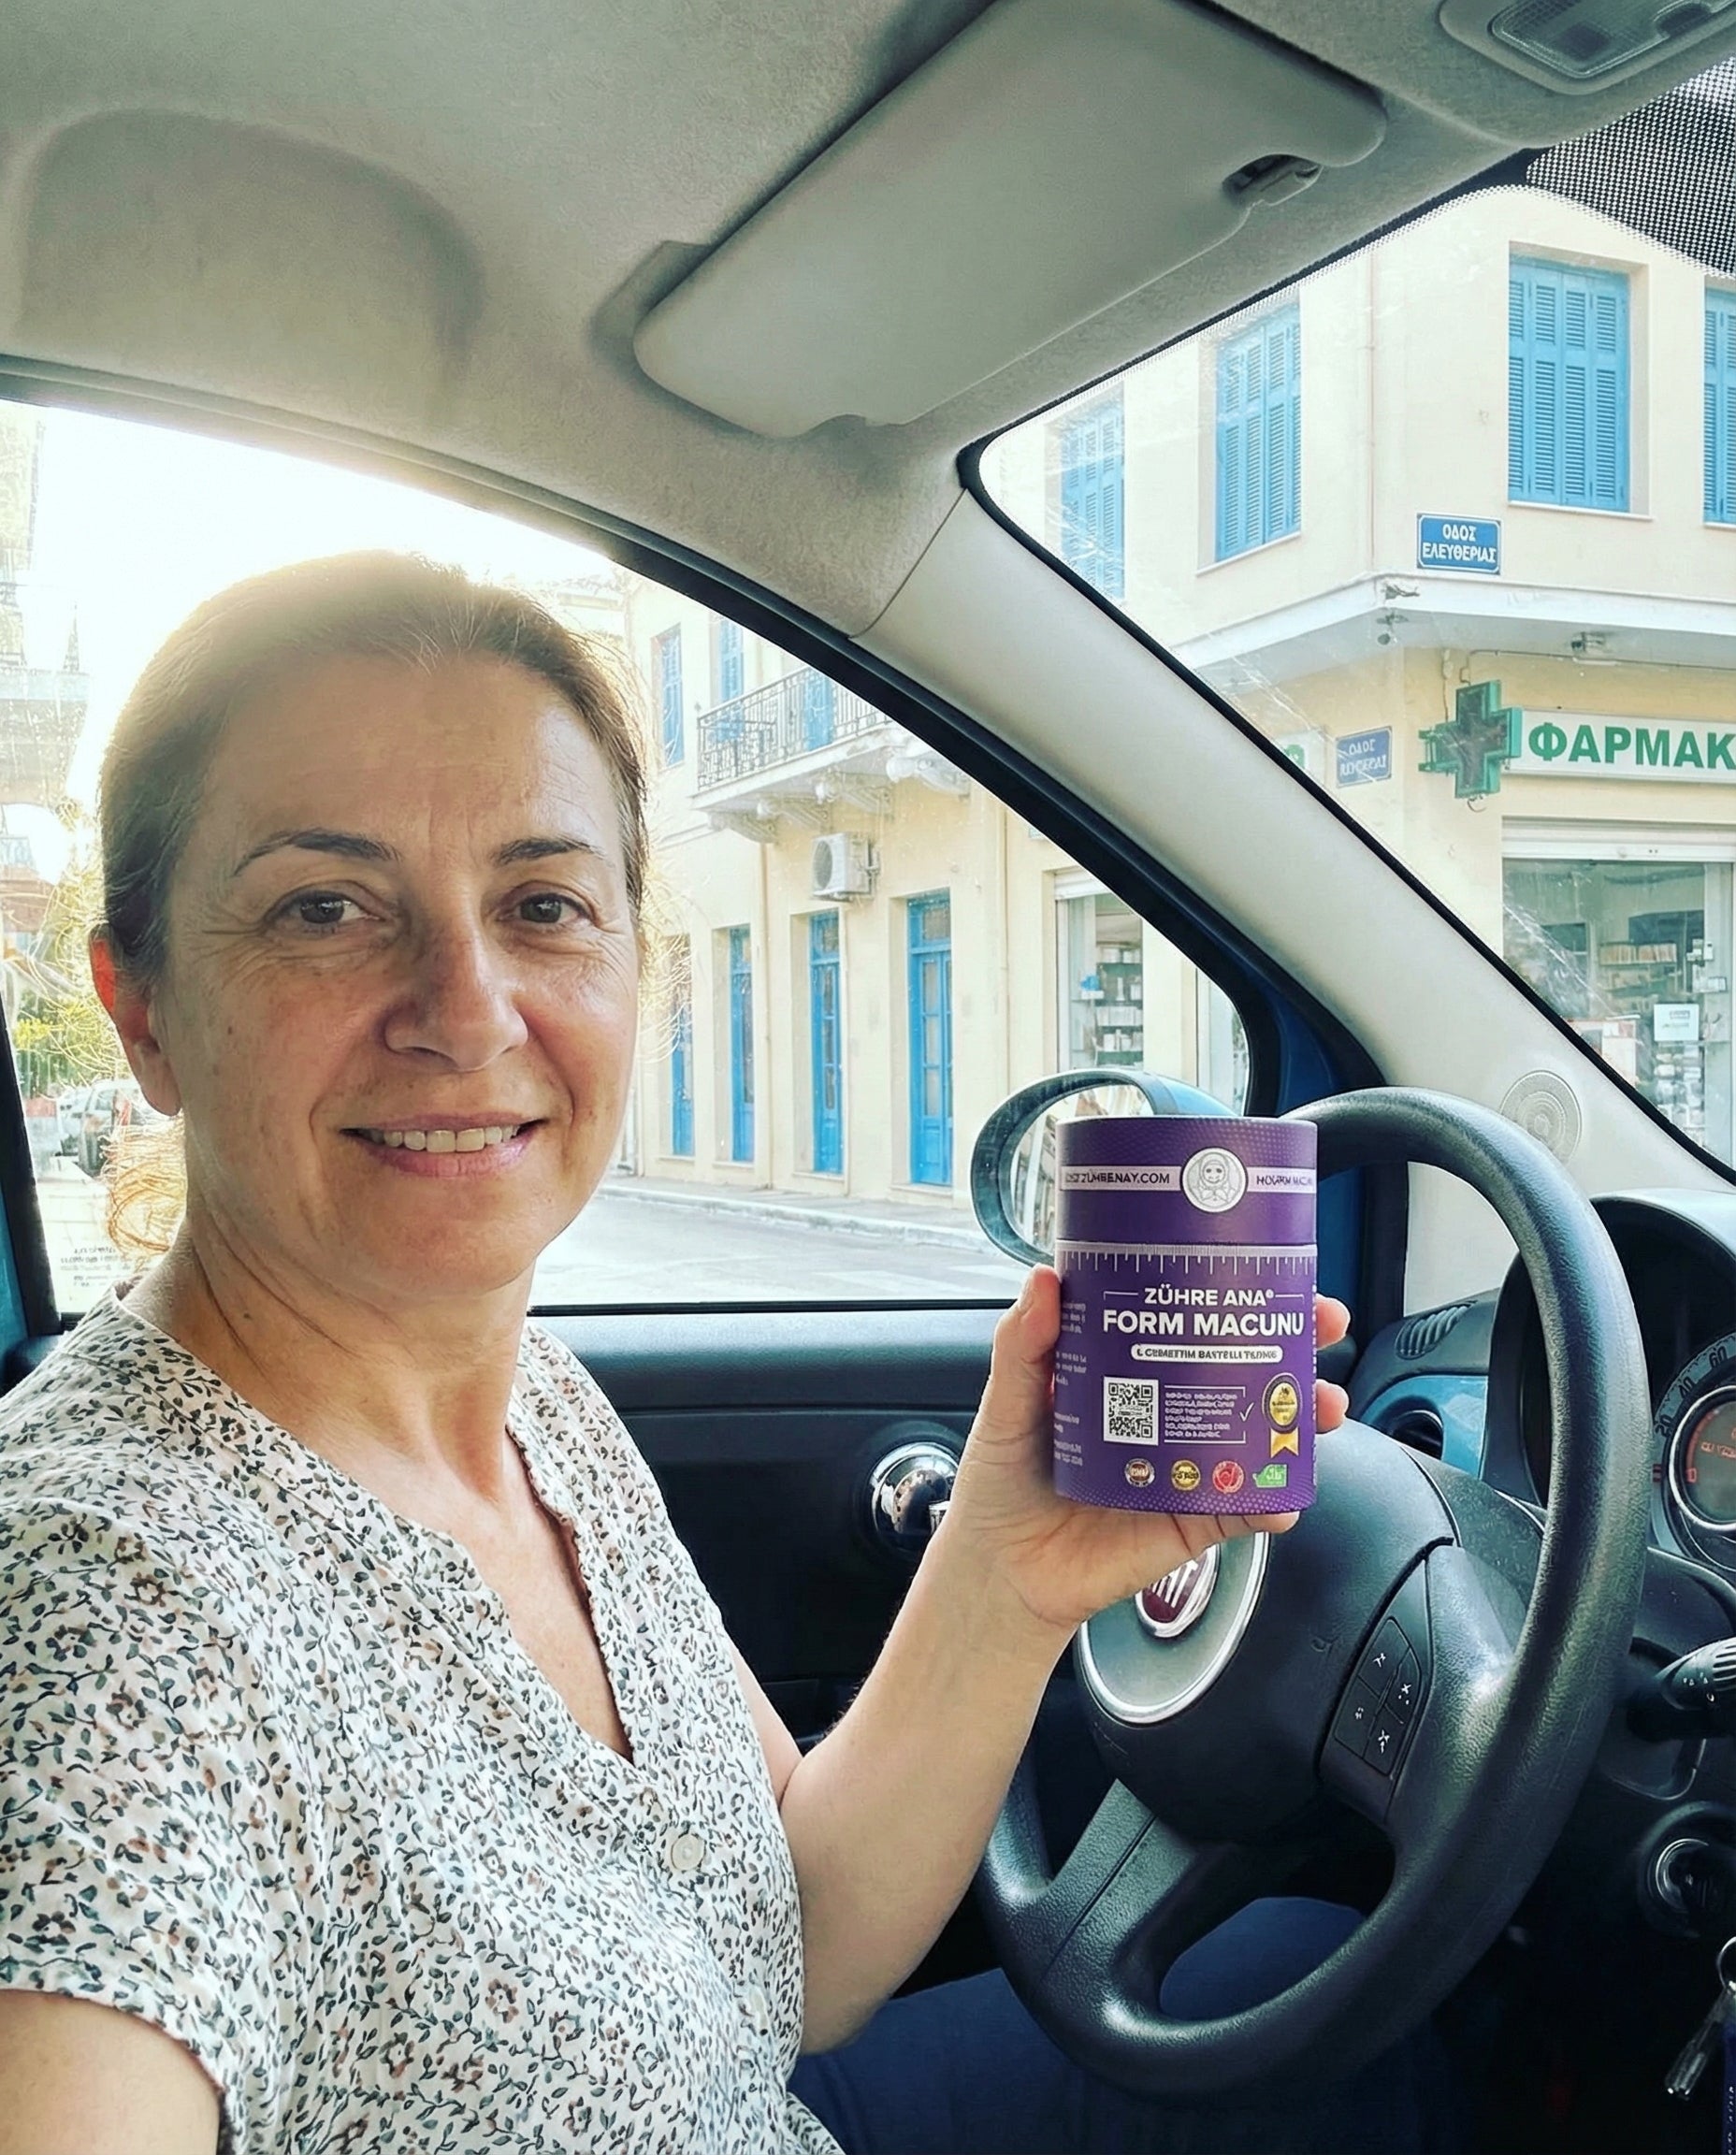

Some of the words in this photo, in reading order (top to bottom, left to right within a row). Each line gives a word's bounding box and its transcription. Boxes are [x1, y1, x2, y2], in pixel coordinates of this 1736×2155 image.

[1442, 524, 1477, 542] ΟΔΟΣ
[1422, 542, 1497, 564] ΕΛΕΥΘΕΡΙΑΣ
[1528, 722, 1736, 770] ΦΑΡΜΑΚ
[1144, 1283, 1218, 1306] ZÜHRE
[1103, 1309, 1184, 1336] FORM
[1194, 1312, 1305, 1337] MACUNU
